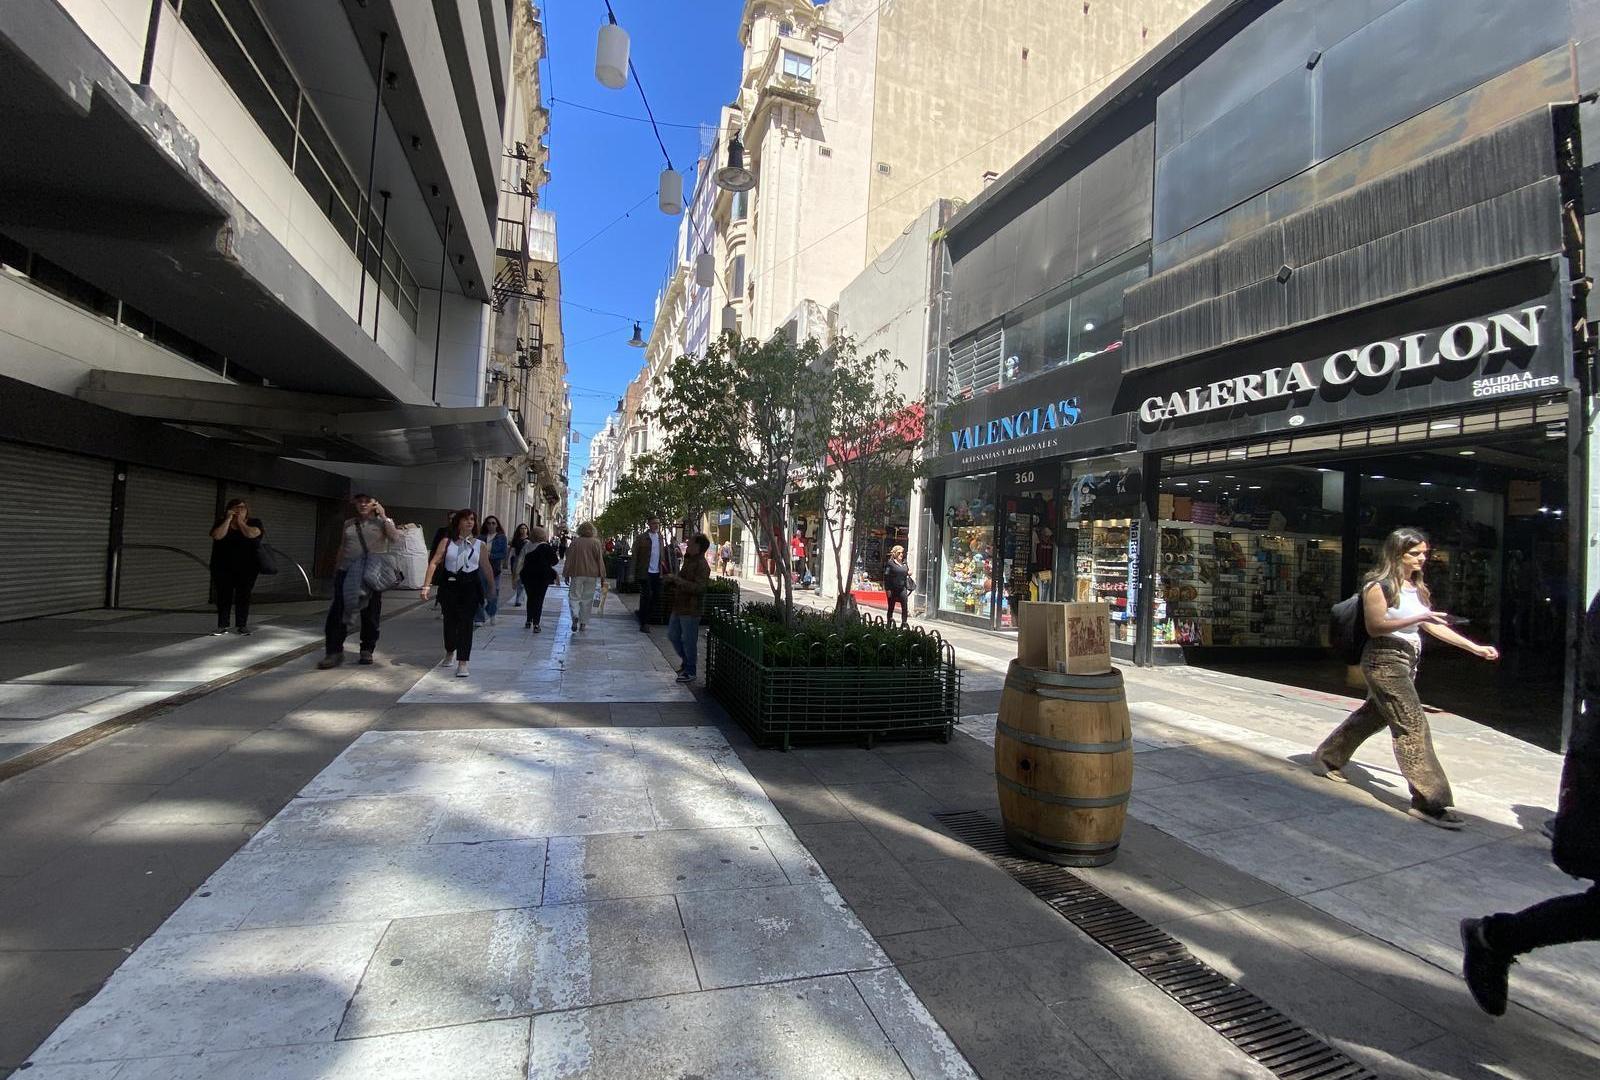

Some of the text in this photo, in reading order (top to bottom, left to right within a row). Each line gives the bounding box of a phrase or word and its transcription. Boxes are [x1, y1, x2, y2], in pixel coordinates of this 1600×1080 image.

[1140, 305, 1547, 423] GALERIA COLON
[1472, 371, 1533, 389] SALIDA A
[1473, 375, 1560, 397] CORRIENTES
[951, 397, 1081, 453] VALENCIA'S
[1007, 439, 1059, 456] REGIONALES
[1015, 471, 1035, 484] 360
